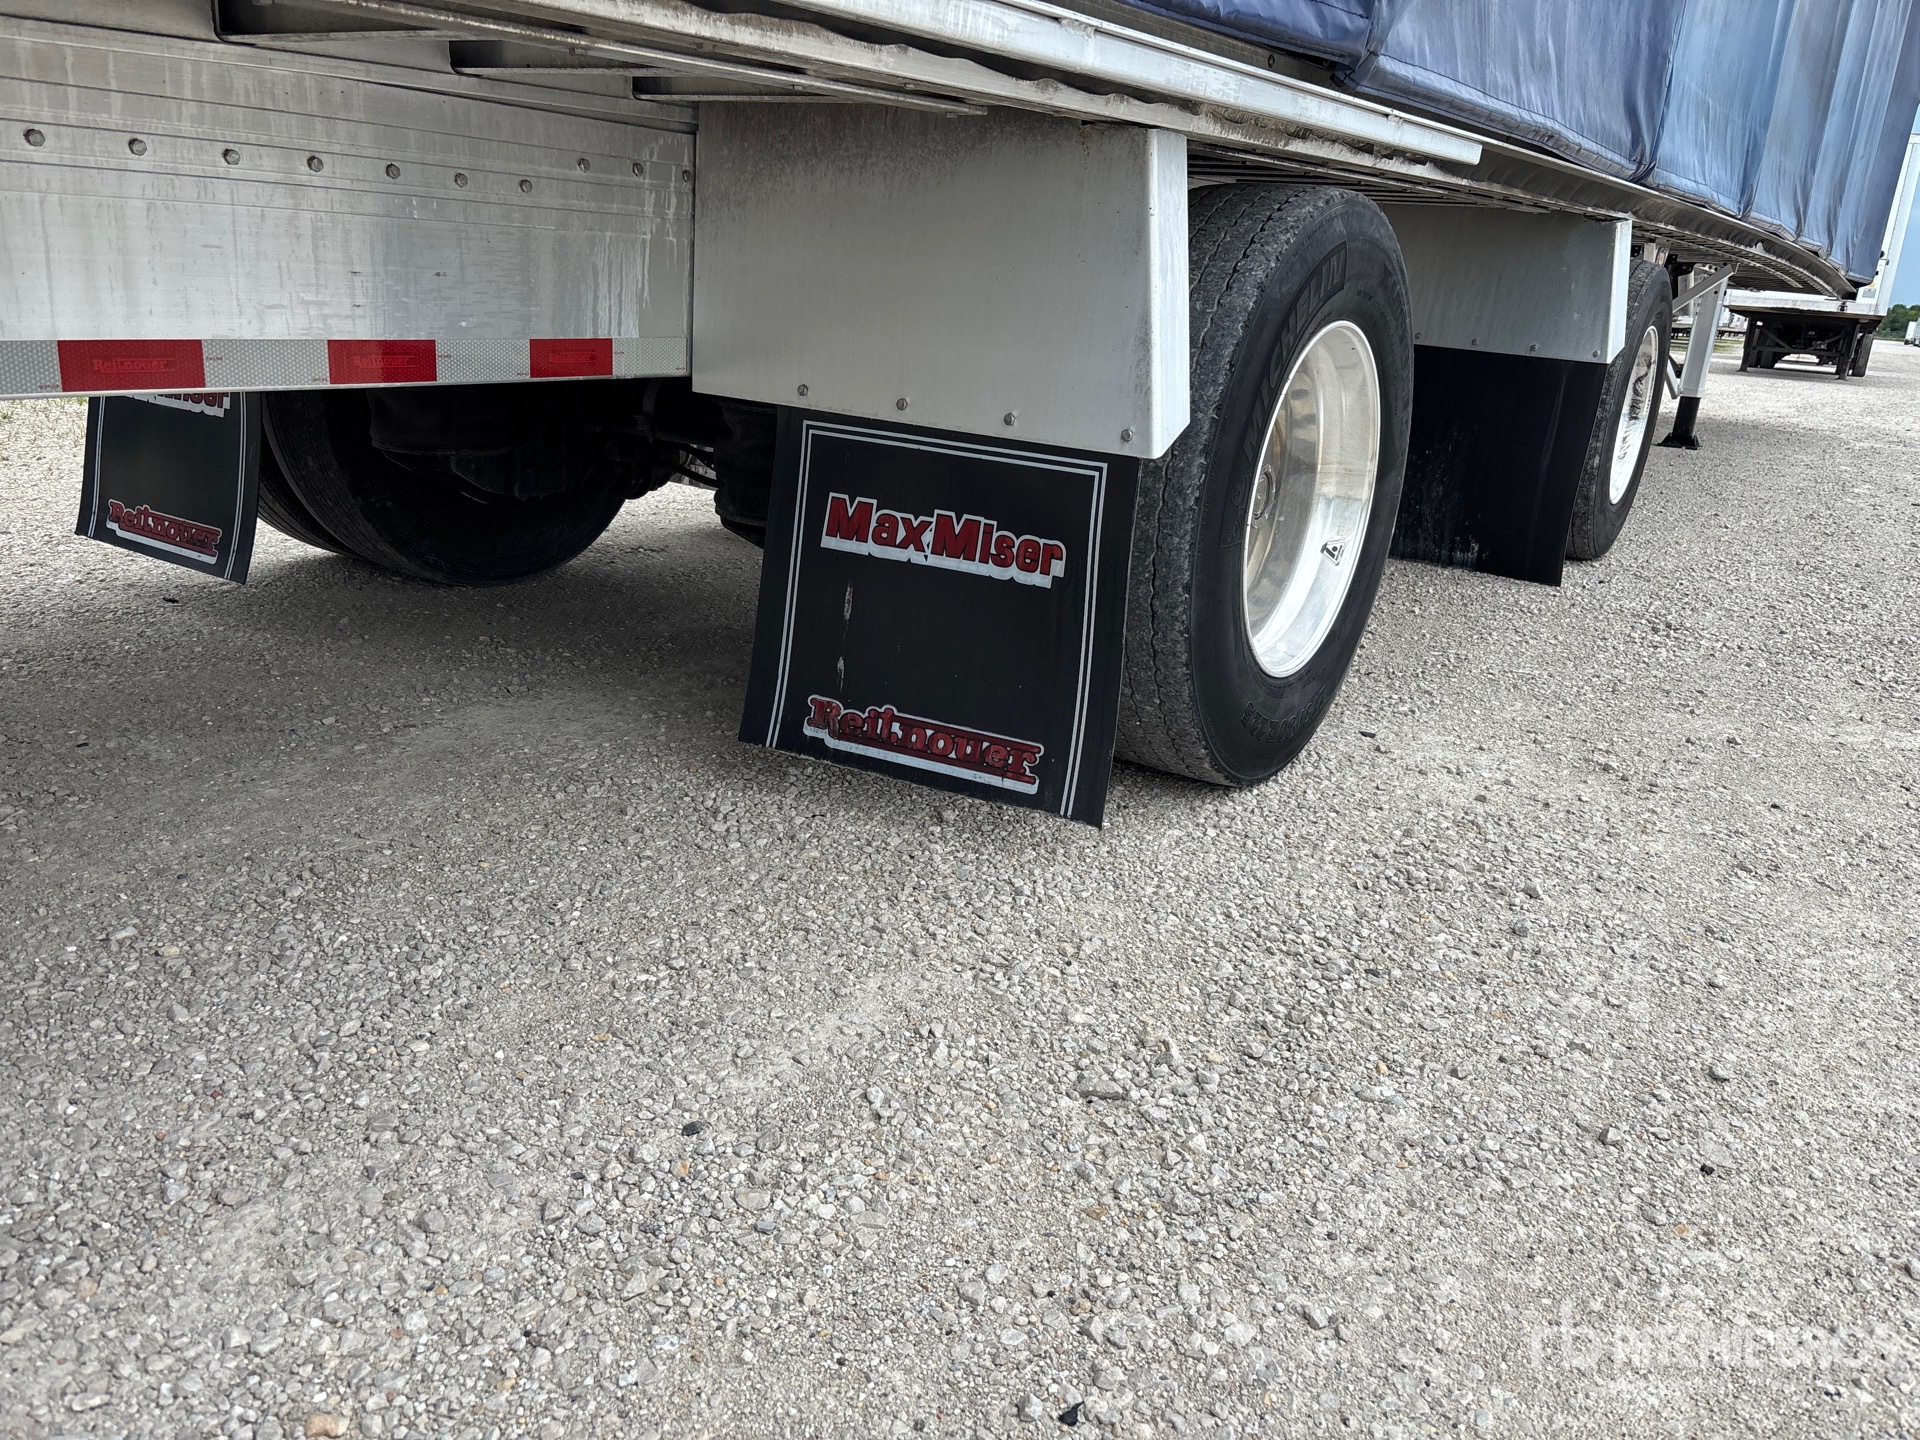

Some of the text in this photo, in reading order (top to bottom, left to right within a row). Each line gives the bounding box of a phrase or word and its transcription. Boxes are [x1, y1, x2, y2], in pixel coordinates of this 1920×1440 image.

[92, 356, 173, 373] Reitnouer
[1243, 249, 1345, 464] MICHELIN
[803, 695, 1044, 792] Reitnouer
